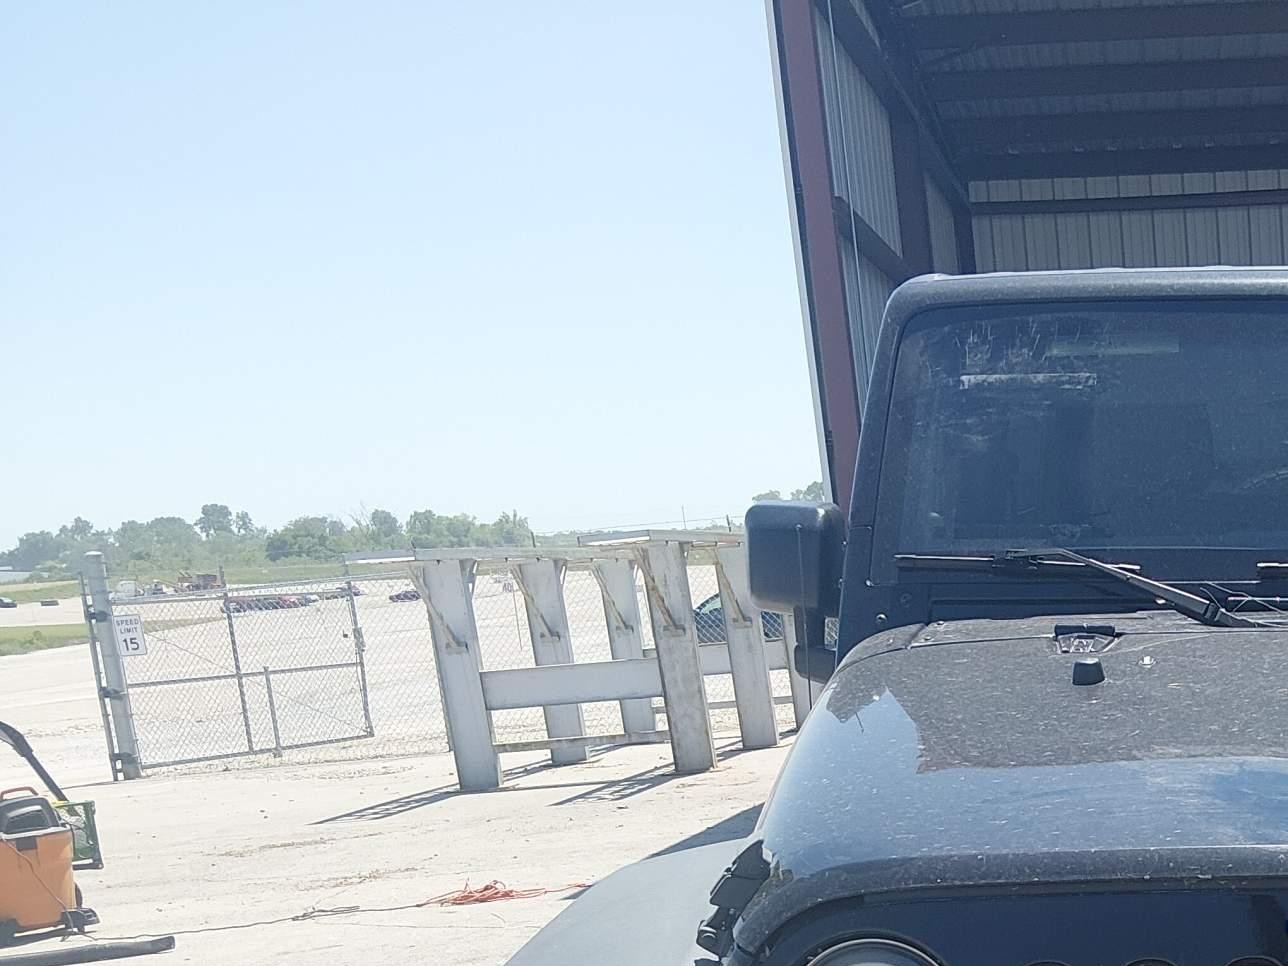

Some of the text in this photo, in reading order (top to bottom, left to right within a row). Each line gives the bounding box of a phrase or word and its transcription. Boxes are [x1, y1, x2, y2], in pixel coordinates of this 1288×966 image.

[116, 618, 139, 626] SPEED
[120, 626, 137, 634] LIMIT
[123, 637, 140, 651] 15
